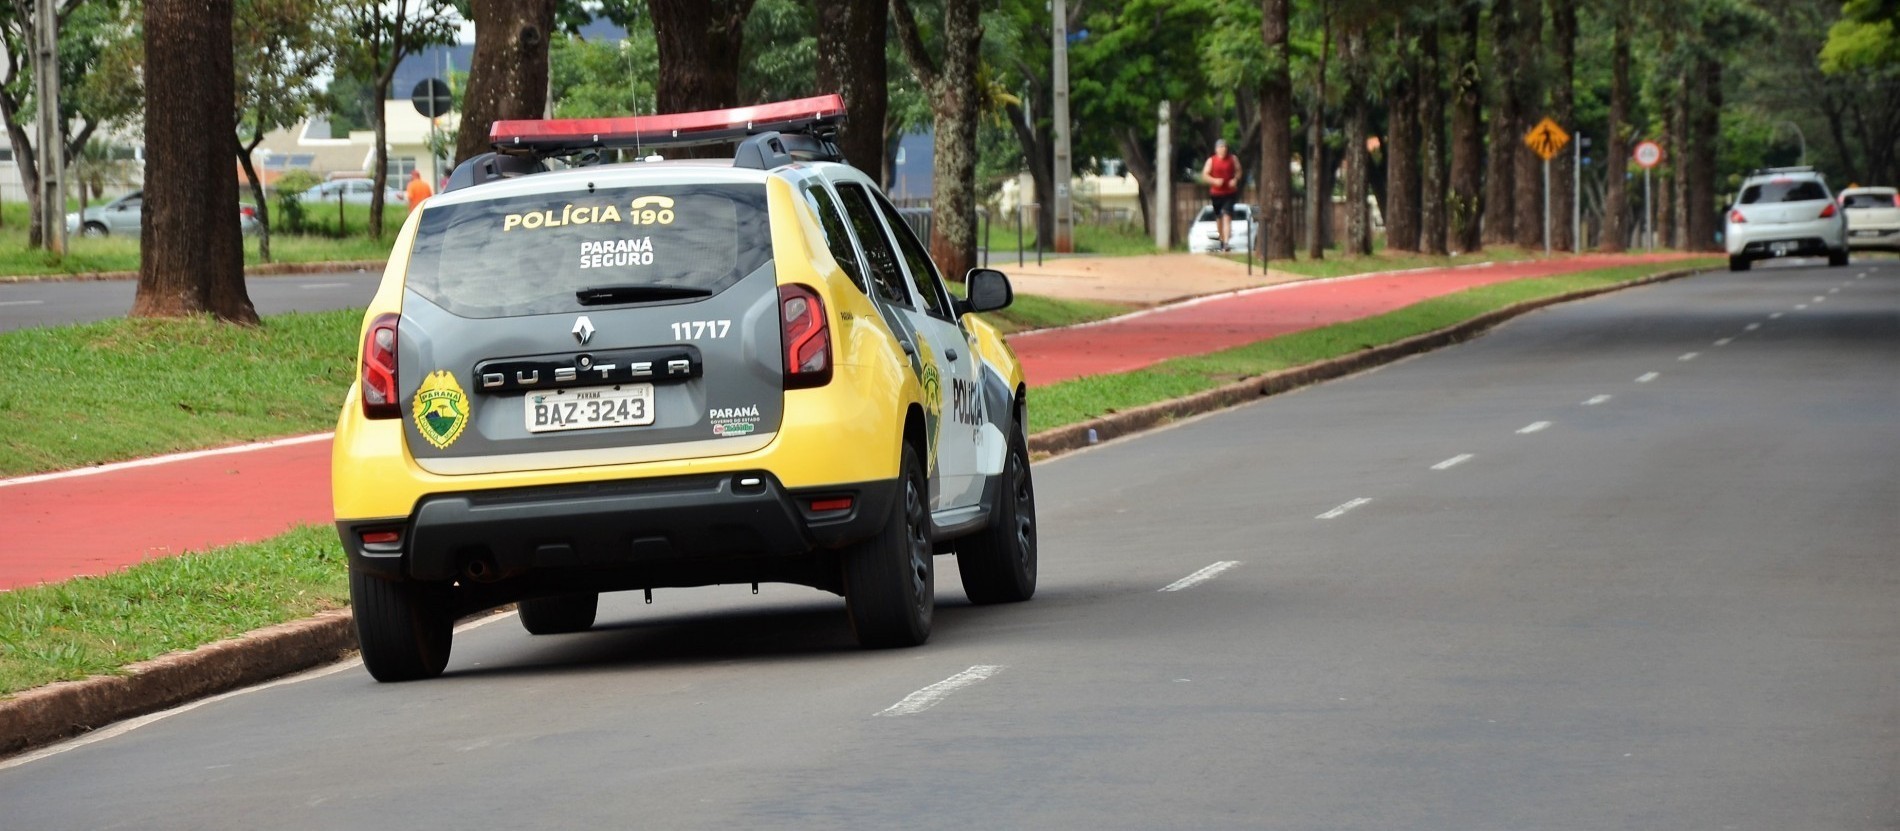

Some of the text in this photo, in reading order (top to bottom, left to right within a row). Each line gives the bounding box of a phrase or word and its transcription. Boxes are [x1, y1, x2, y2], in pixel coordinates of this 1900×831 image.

[503, 204, 675, 232] POLÍCIA 190
[580, 237, 653, 255] PARANÁ
[580, 252, 654, 268] SEGURO
[671, 319, 732, 341] 11717
[483, 360, 690, 387] DUSTER
[709, 404, 759, 418] PARANÁ
